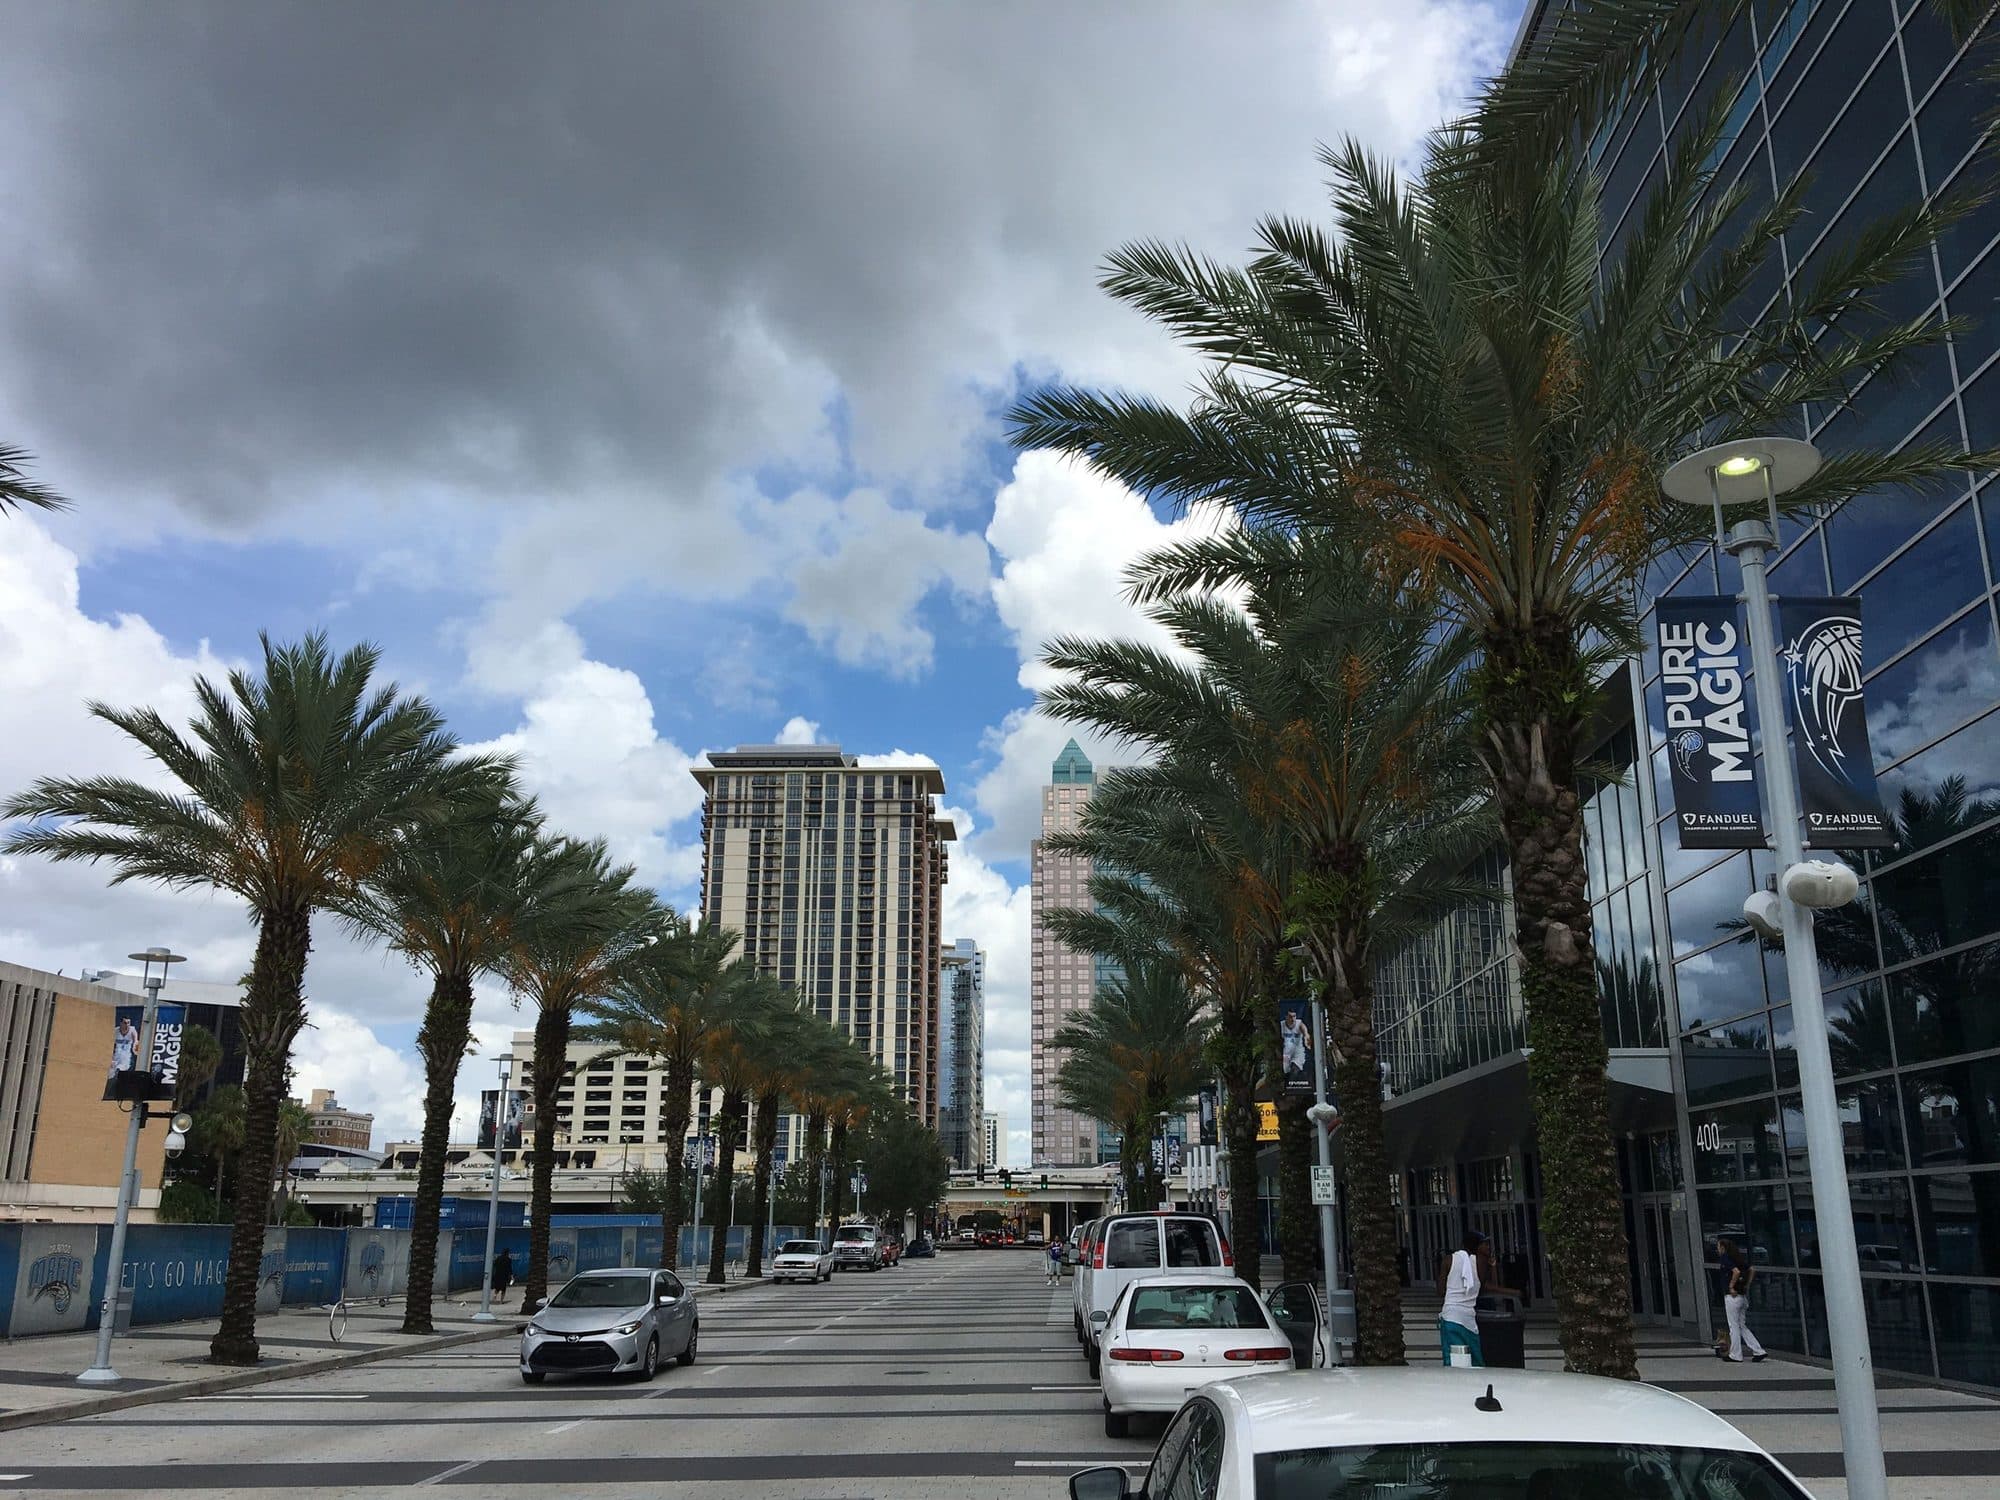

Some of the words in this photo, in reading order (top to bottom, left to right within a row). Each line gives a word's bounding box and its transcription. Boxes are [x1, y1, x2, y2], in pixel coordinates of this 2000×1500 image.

[1661, 622, 1703, 728] PURE
[1695, 620, 1753, 782] MAGIC
[1699, 814, 1757, 824] FANDUEL
[1826, 814, 1881, 824] FANDUEL
[152, 1023, 169, 1063] PURE
[161, 1023, 183, 1084] MAGIC
[1697, 1122, 1720, 1151] 400
[121, 1261, 156, 1288] ET'S
[165, 1260, 185, 1288] GO
